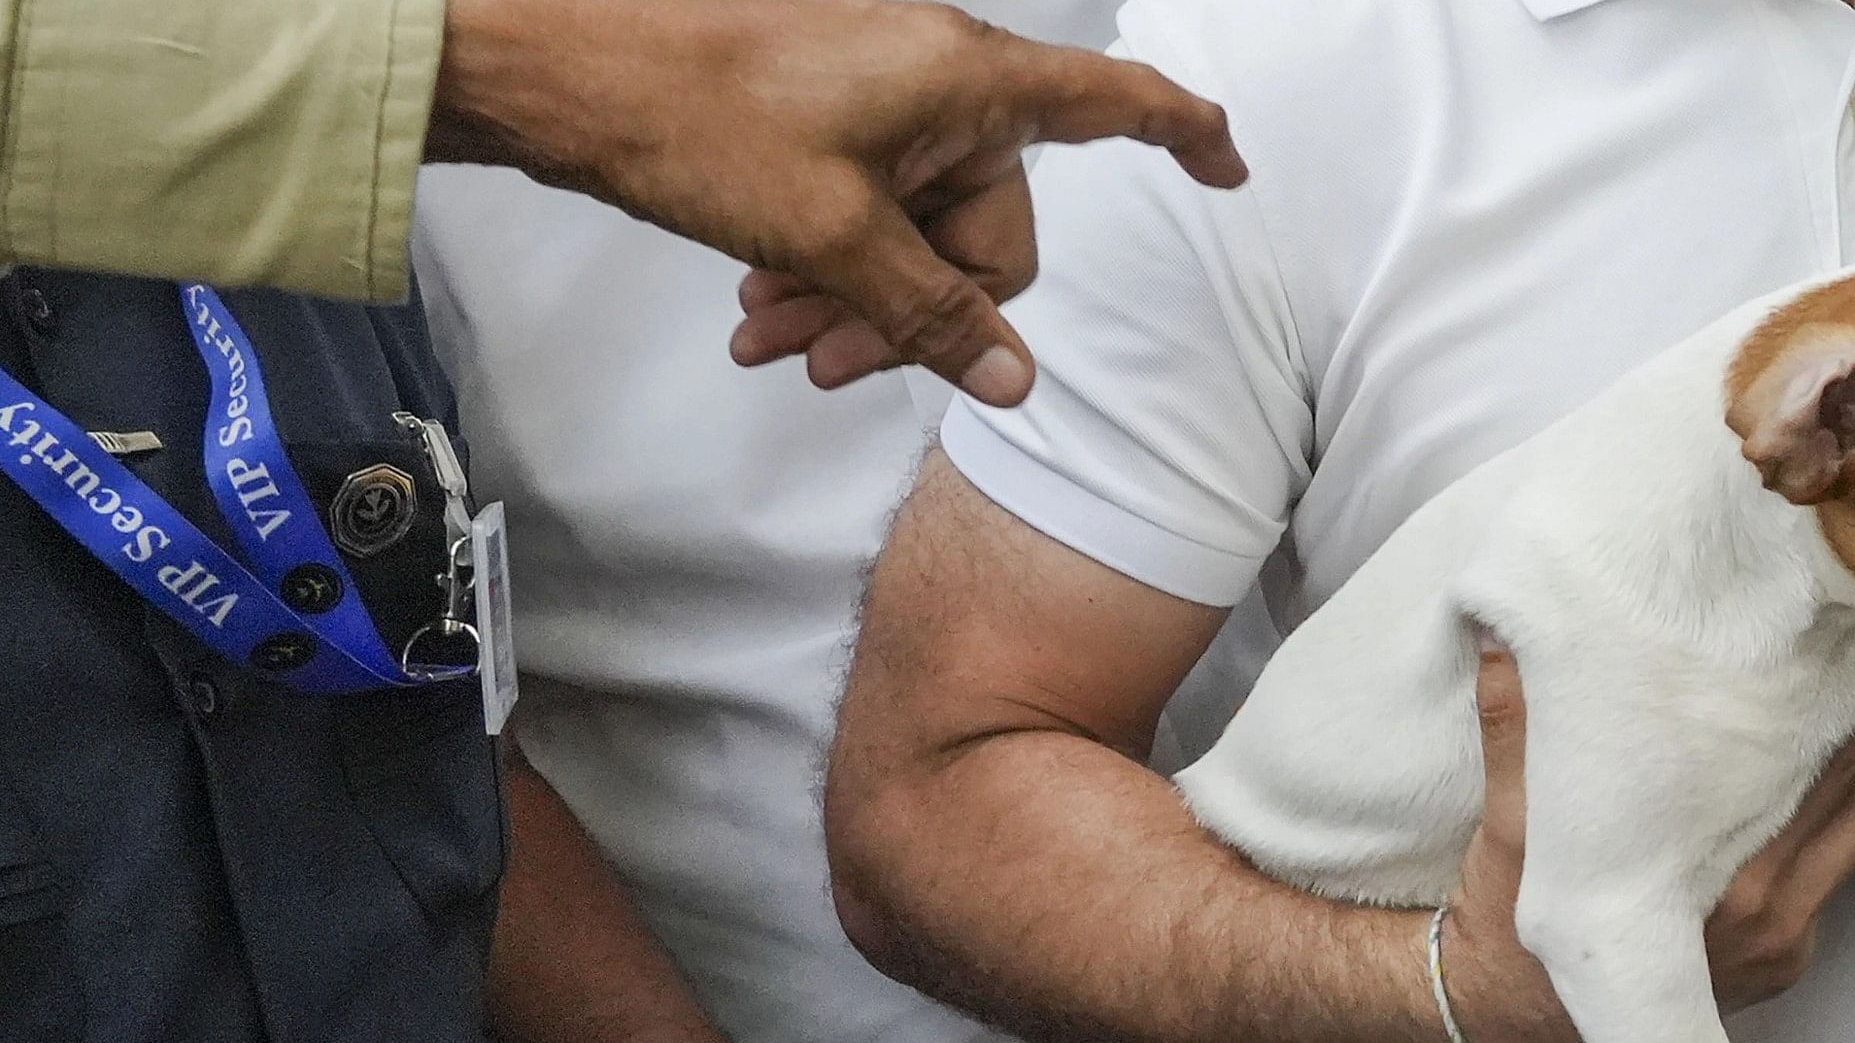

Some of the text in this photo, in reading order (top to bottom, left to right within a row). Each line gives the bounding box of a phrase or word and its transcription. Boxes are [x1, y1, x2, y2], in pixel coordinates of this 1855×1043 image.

[0, 401, 240, 628] VIP Security
[186, 284, 291, 542] VIP Security
